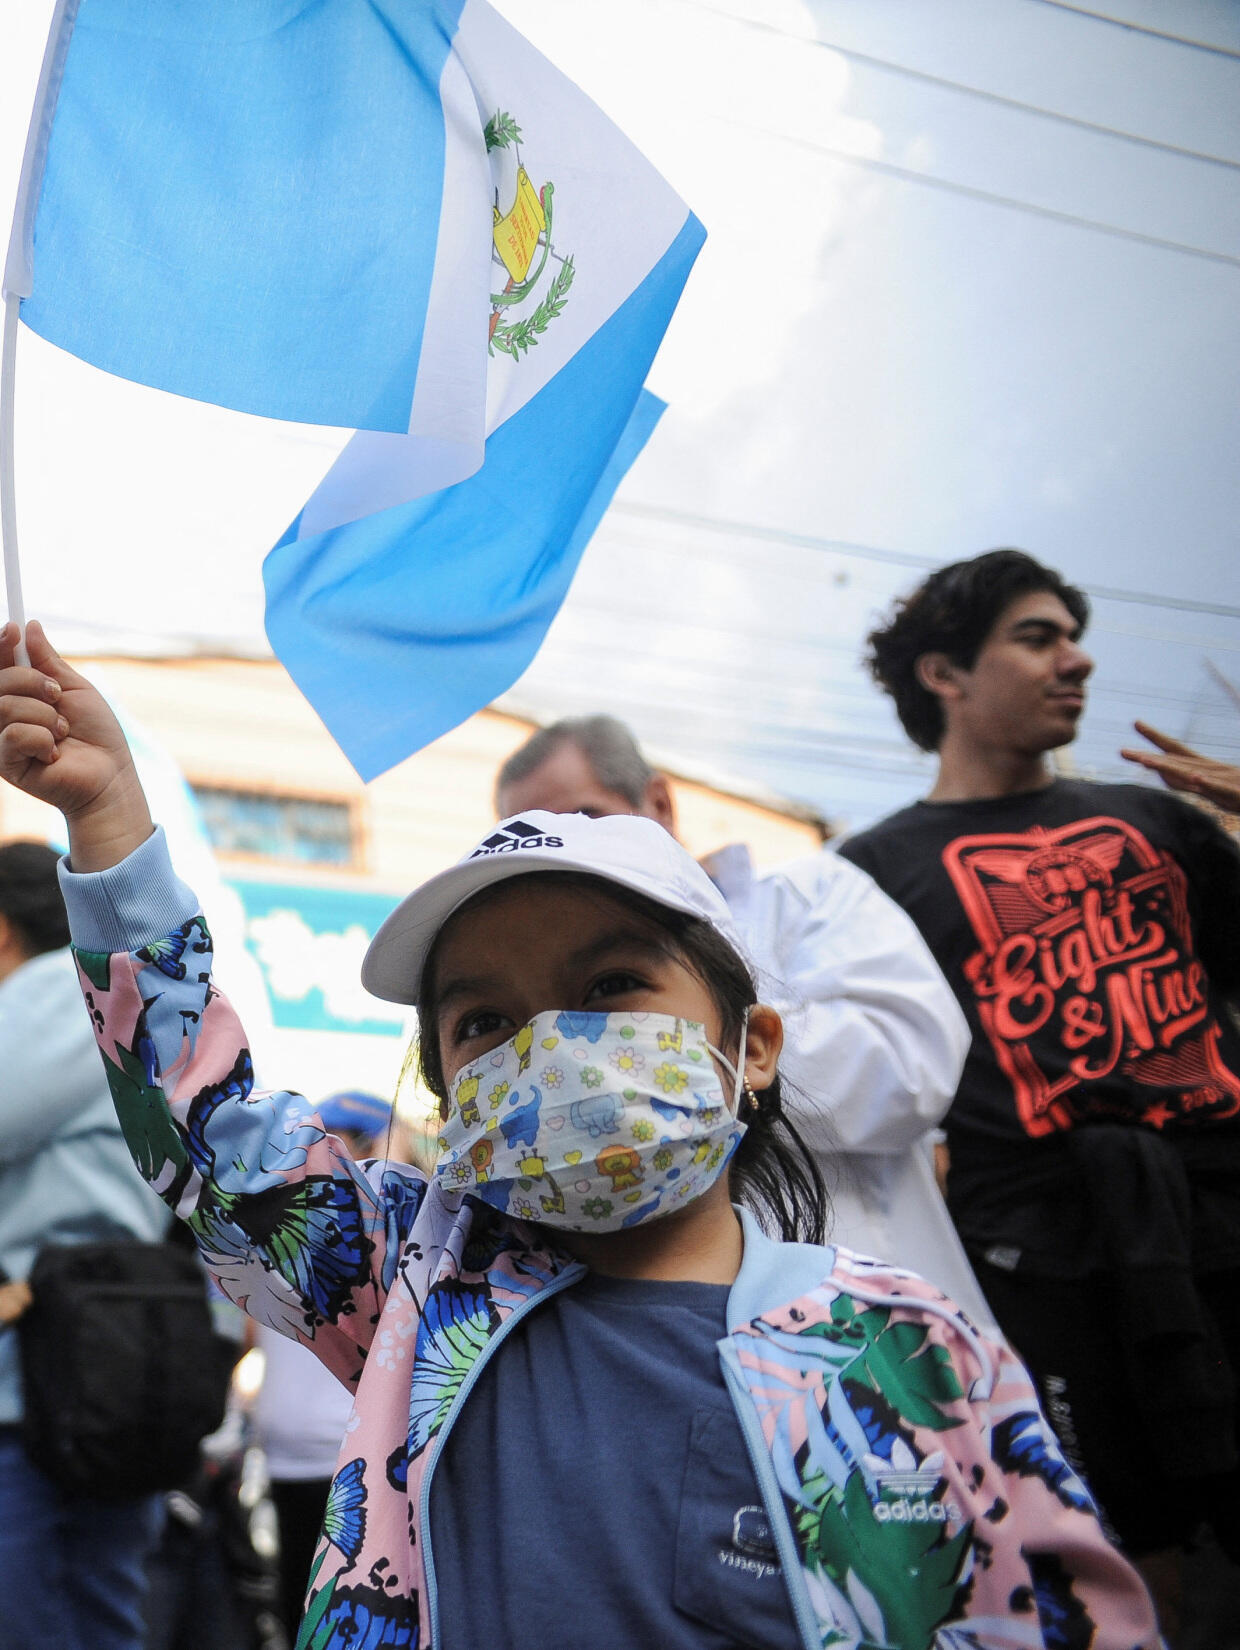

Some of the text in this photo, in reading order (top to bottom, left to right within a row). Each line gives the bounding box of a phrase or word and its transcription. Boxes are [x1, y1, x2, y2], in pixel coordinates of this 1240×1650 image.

[974, 887, 1165, 1039] Eight
[1061, 949, 1206, 1080] & Nine
[873, 1498, 962, 1522] adidas
[720, 1550, 781, 1579] vineya
